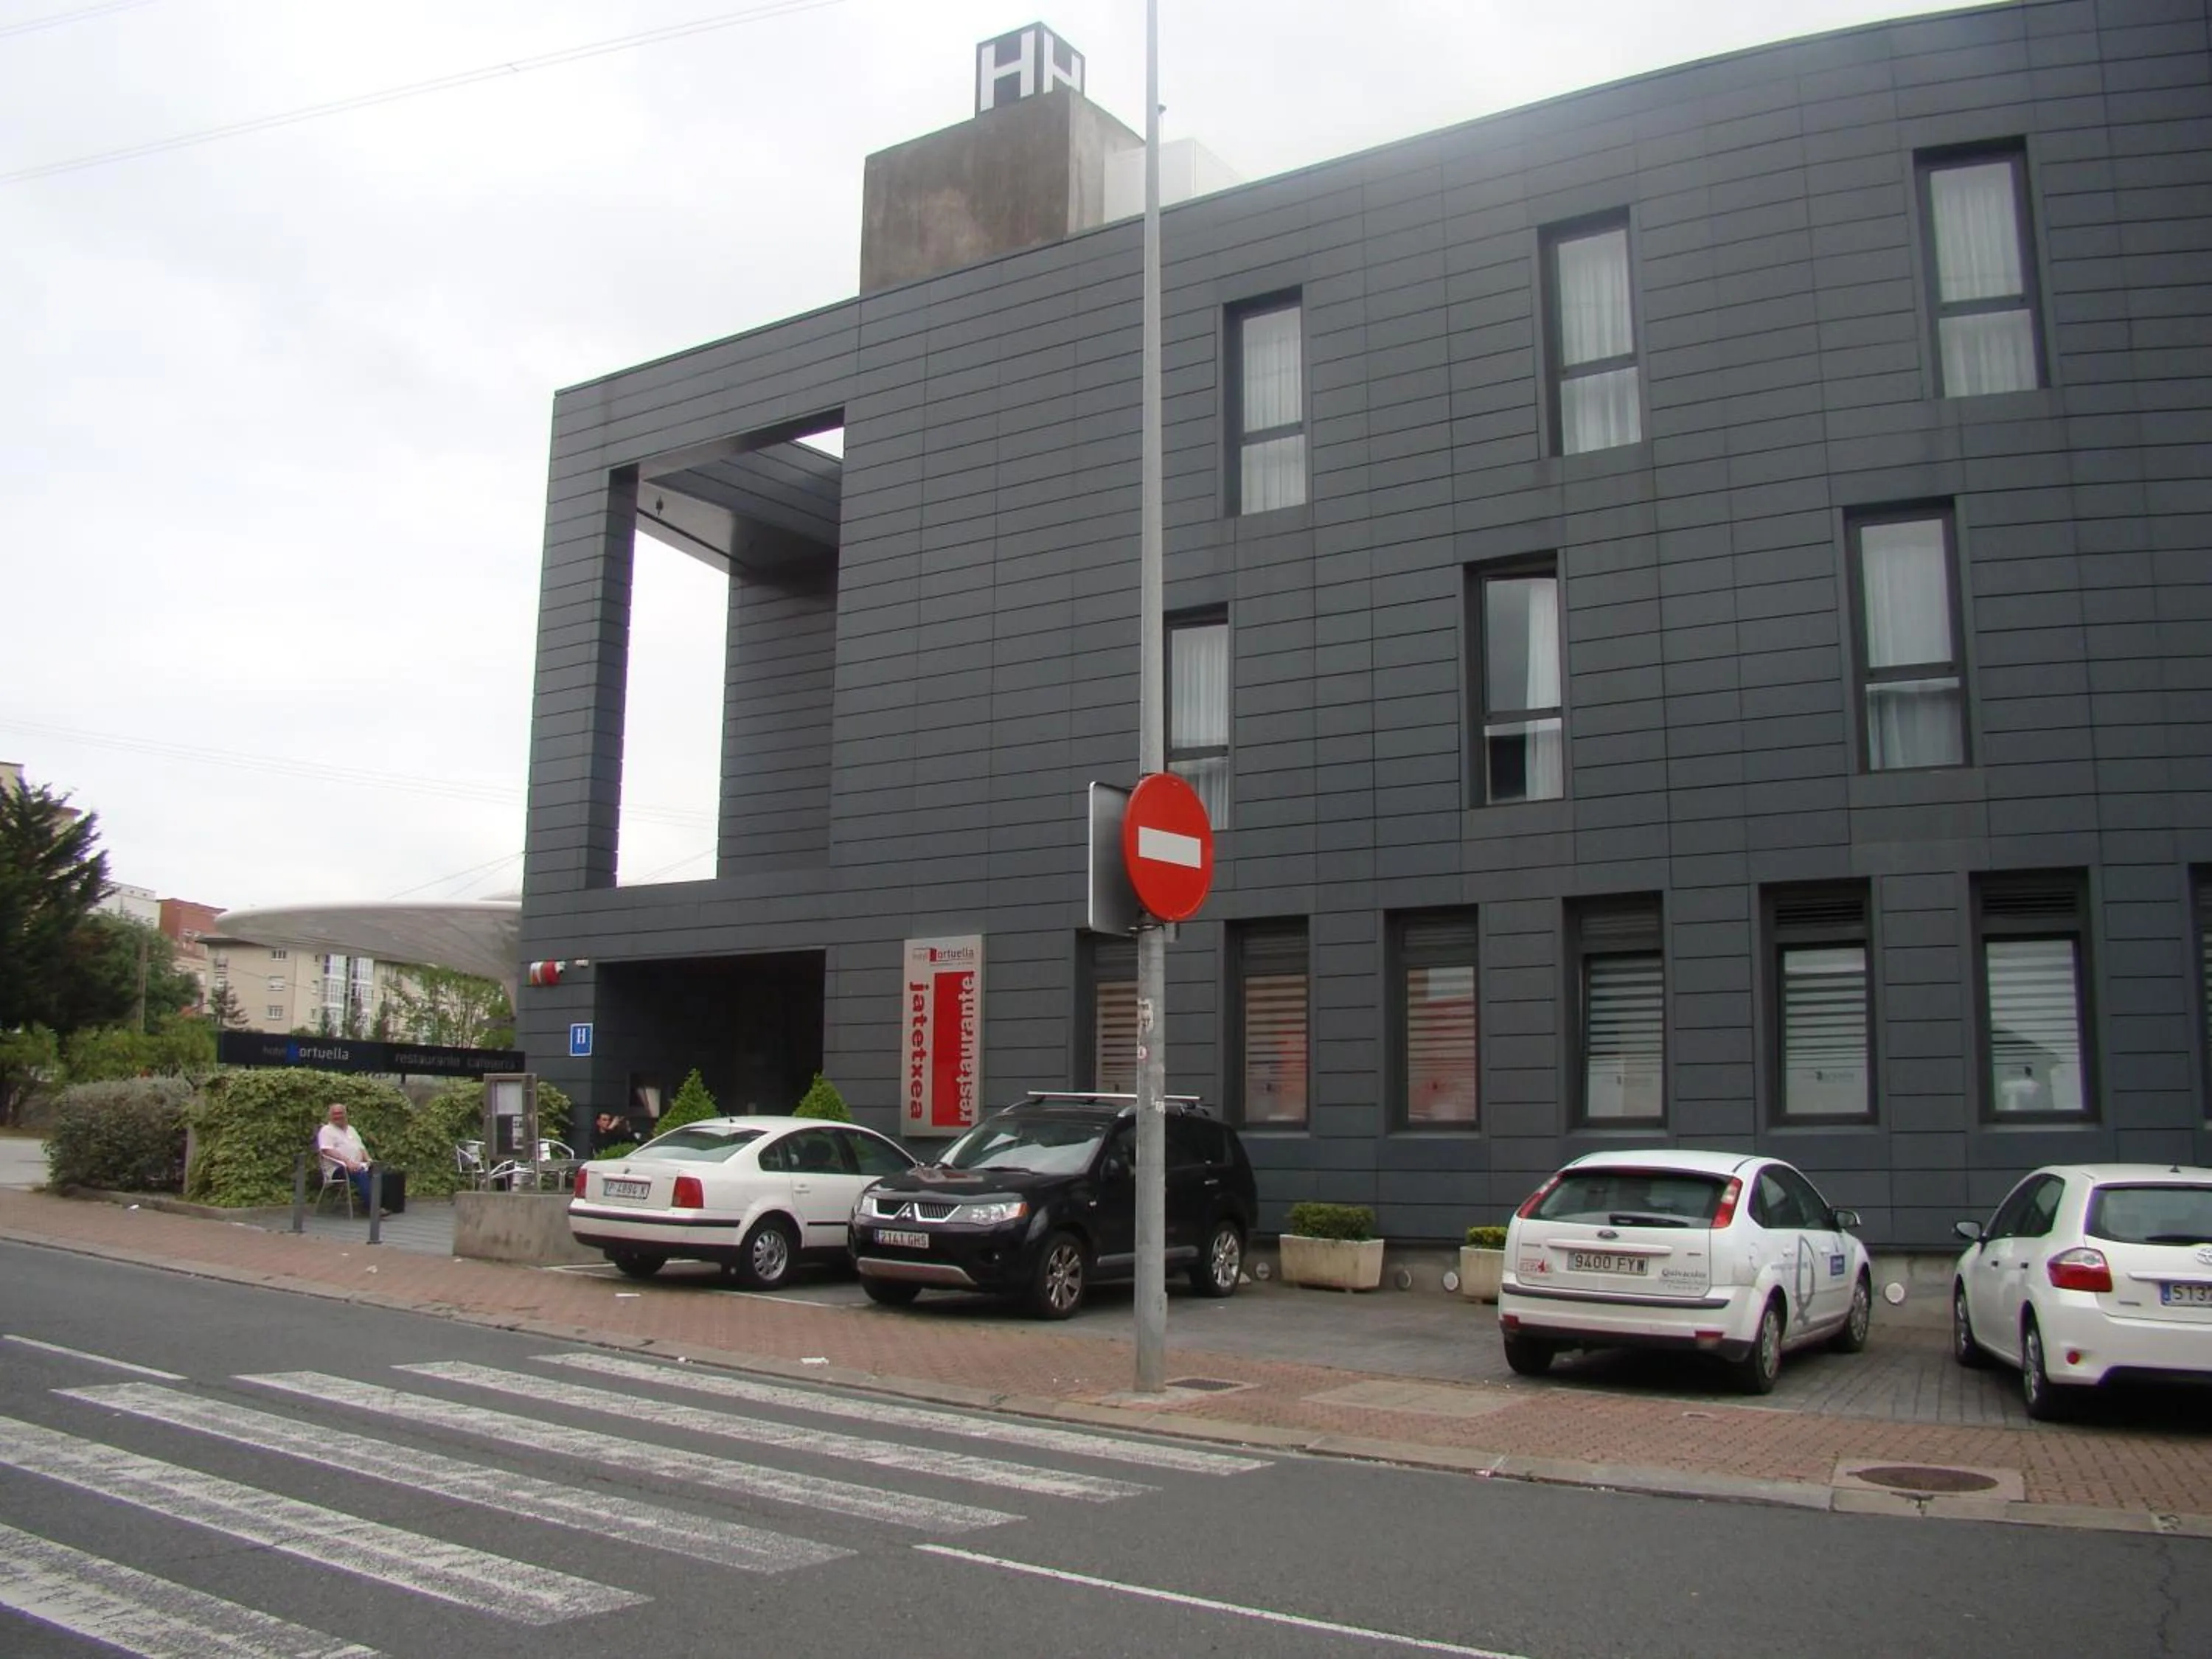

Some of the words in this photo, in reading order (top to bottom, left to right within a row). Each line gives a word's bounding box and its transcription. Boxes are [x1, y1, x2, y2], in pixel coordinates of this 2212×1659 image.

[980, 29, 1035, 112] H
[938, 946, 974, 959] ortuella
[577, 1027, 586, 1045] H
[299, 1047, 349, 1060] ortuella
[909, 981, 929, 1119] jatetxea
[956, 976, 974, 1121] restaurante
[1576, 1254, 1611, 1269] 9400
